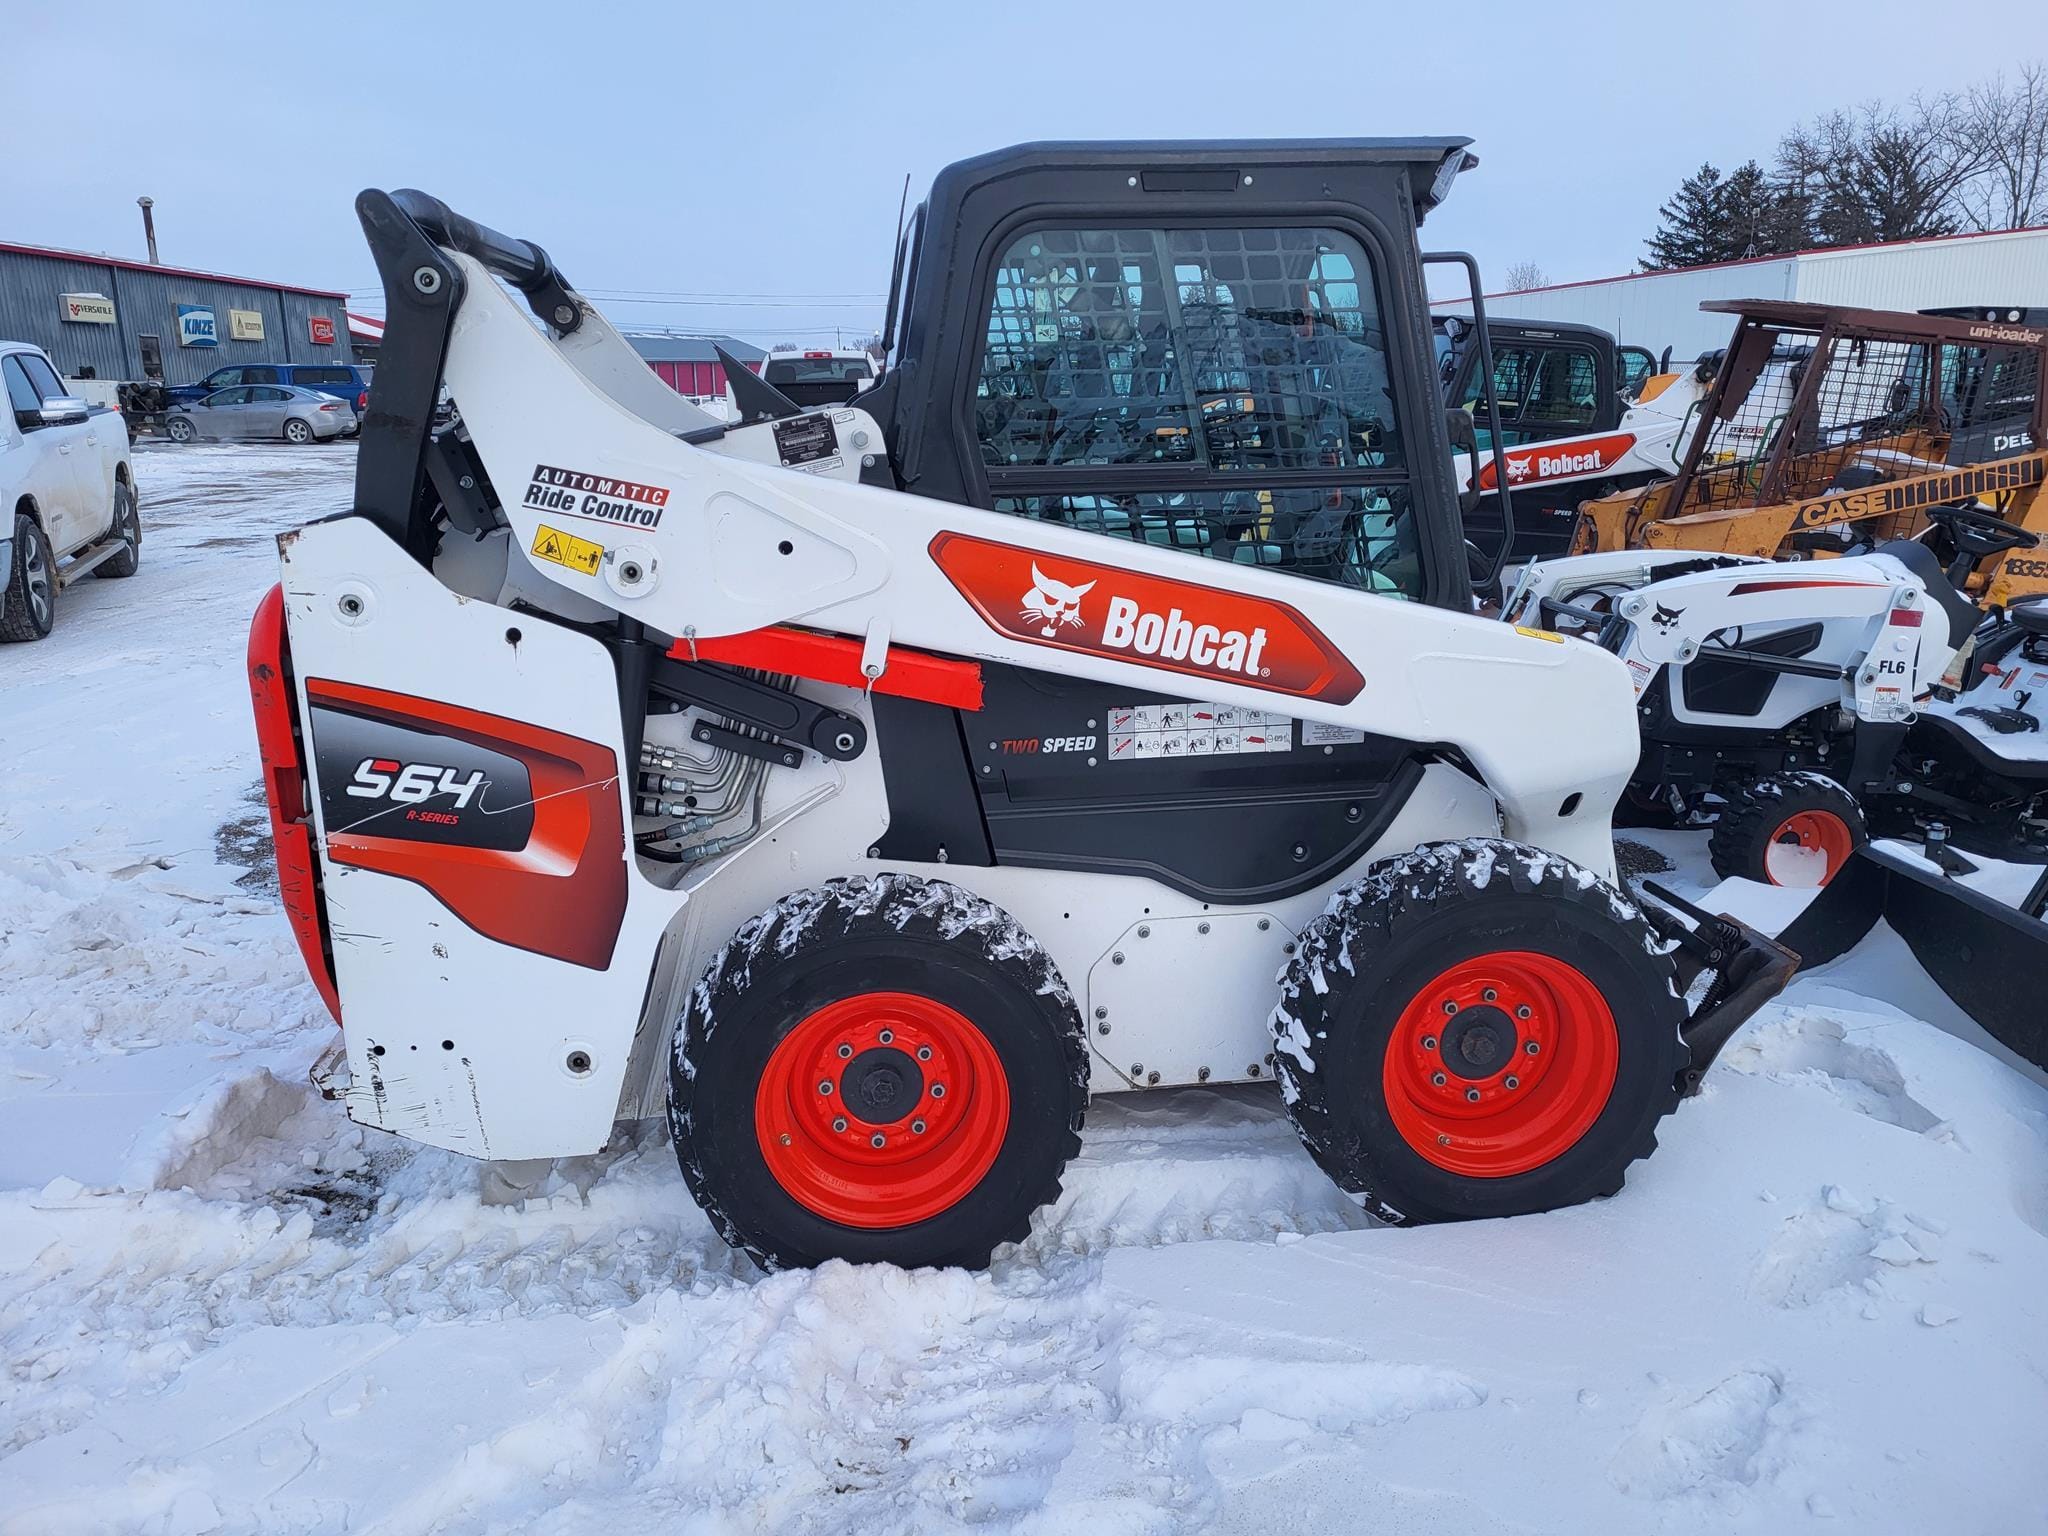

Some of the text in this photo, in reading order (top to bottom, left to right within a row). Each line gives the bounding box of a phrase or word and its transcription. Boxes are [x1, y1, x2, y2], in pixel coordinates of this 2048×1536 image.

[80, 304, 113, 315] VERSATILE
[184, 318, 214, 336] KINZE
[1969, 325, 2044, 343] uni-loader
[1994, 432, 2033, 452] DEE
[1538, 449, 1601, 477] Bobcat
[538, 468, 664, 504] AUTOMATIC
[523, 483, 663, 528] Ride Control
[1802, 490, 1889, 526] CASE
[1101, 596, 1271, 677] Bobcat
[1878, 660, 1906, 674] FL6
[1002, 735, 1097, 755] TWO SPEED
[346, 759, 484, 808] S64
[406, 810, 460, 825] R-SERIES
